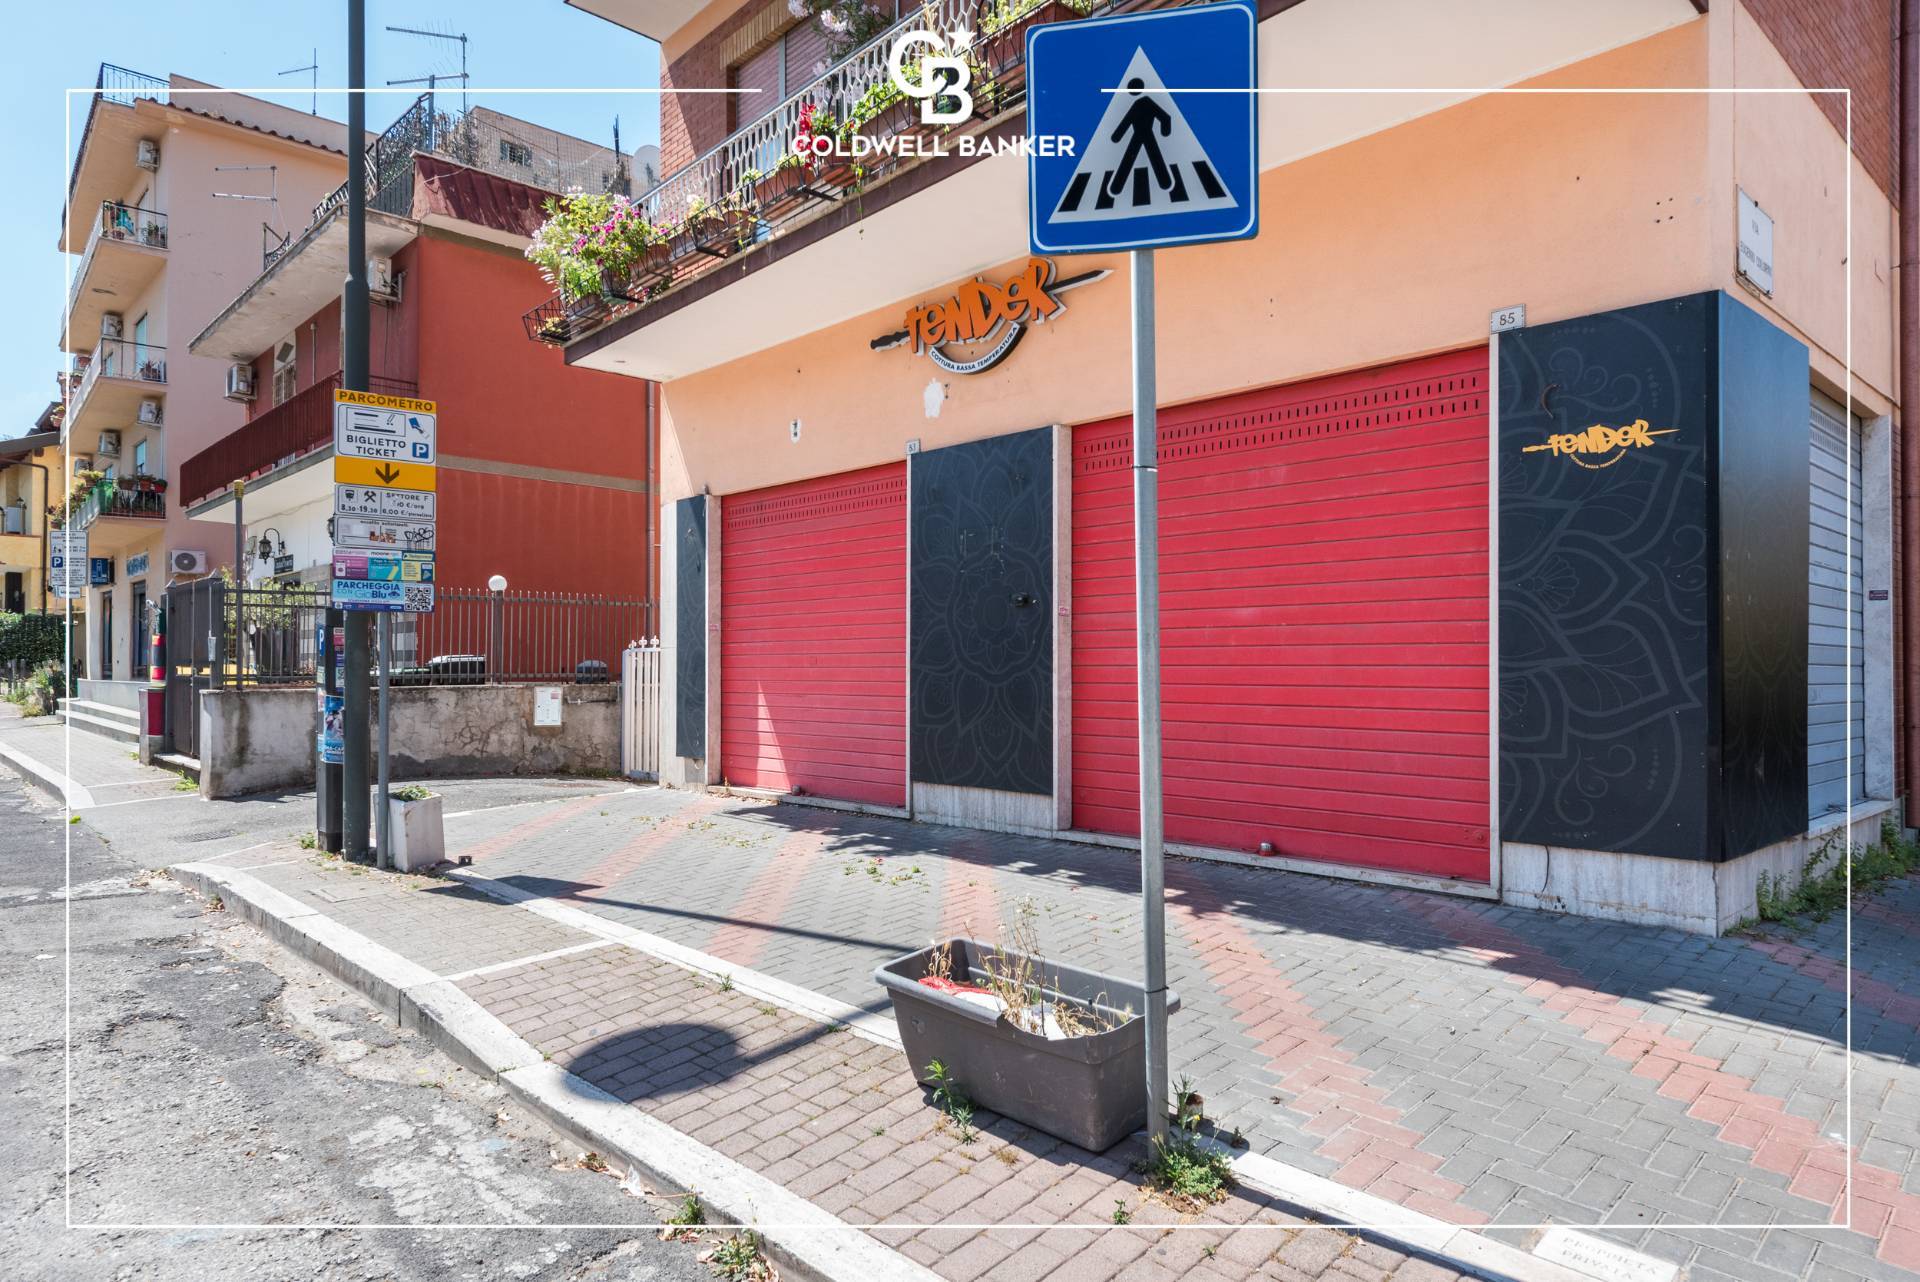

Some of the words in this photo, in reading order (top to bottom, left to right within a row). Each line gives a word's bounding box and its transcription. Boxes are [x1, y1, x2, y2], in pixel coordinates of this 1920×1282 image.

[1499, 311, 1516, 326] 85
[931, 350, 955, 371] COTTURA
[956, 363, 976, 371] BASSA
[977, 326, 1019, 368] TEMPERATURA
[339, 391, 433, 411] PARCOMETRO
[346, 434, 406, 449] BIGLIETTO
[356, 446, 397, 458] TICKET
[337, 581, 400, 591] PARCHEGGIA
